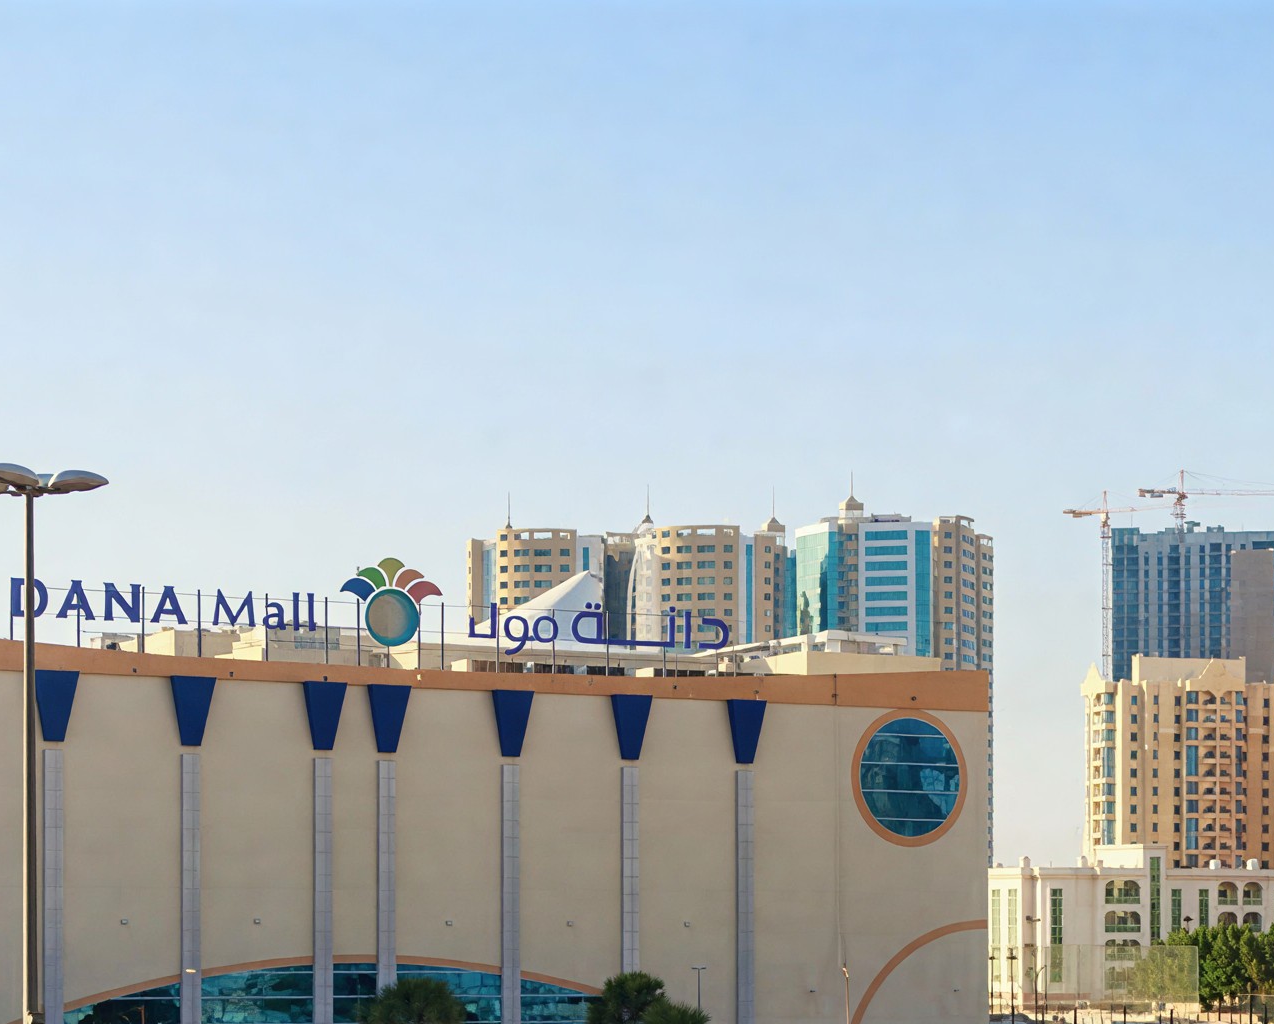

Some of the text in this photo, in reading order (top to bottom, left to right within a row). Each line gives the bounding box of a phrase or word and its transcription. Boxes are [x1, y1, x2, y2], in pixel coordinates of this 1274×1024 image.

[10, 577, 317, 631] DANA Mall
[468, 602, 730, 656] دانة مول
